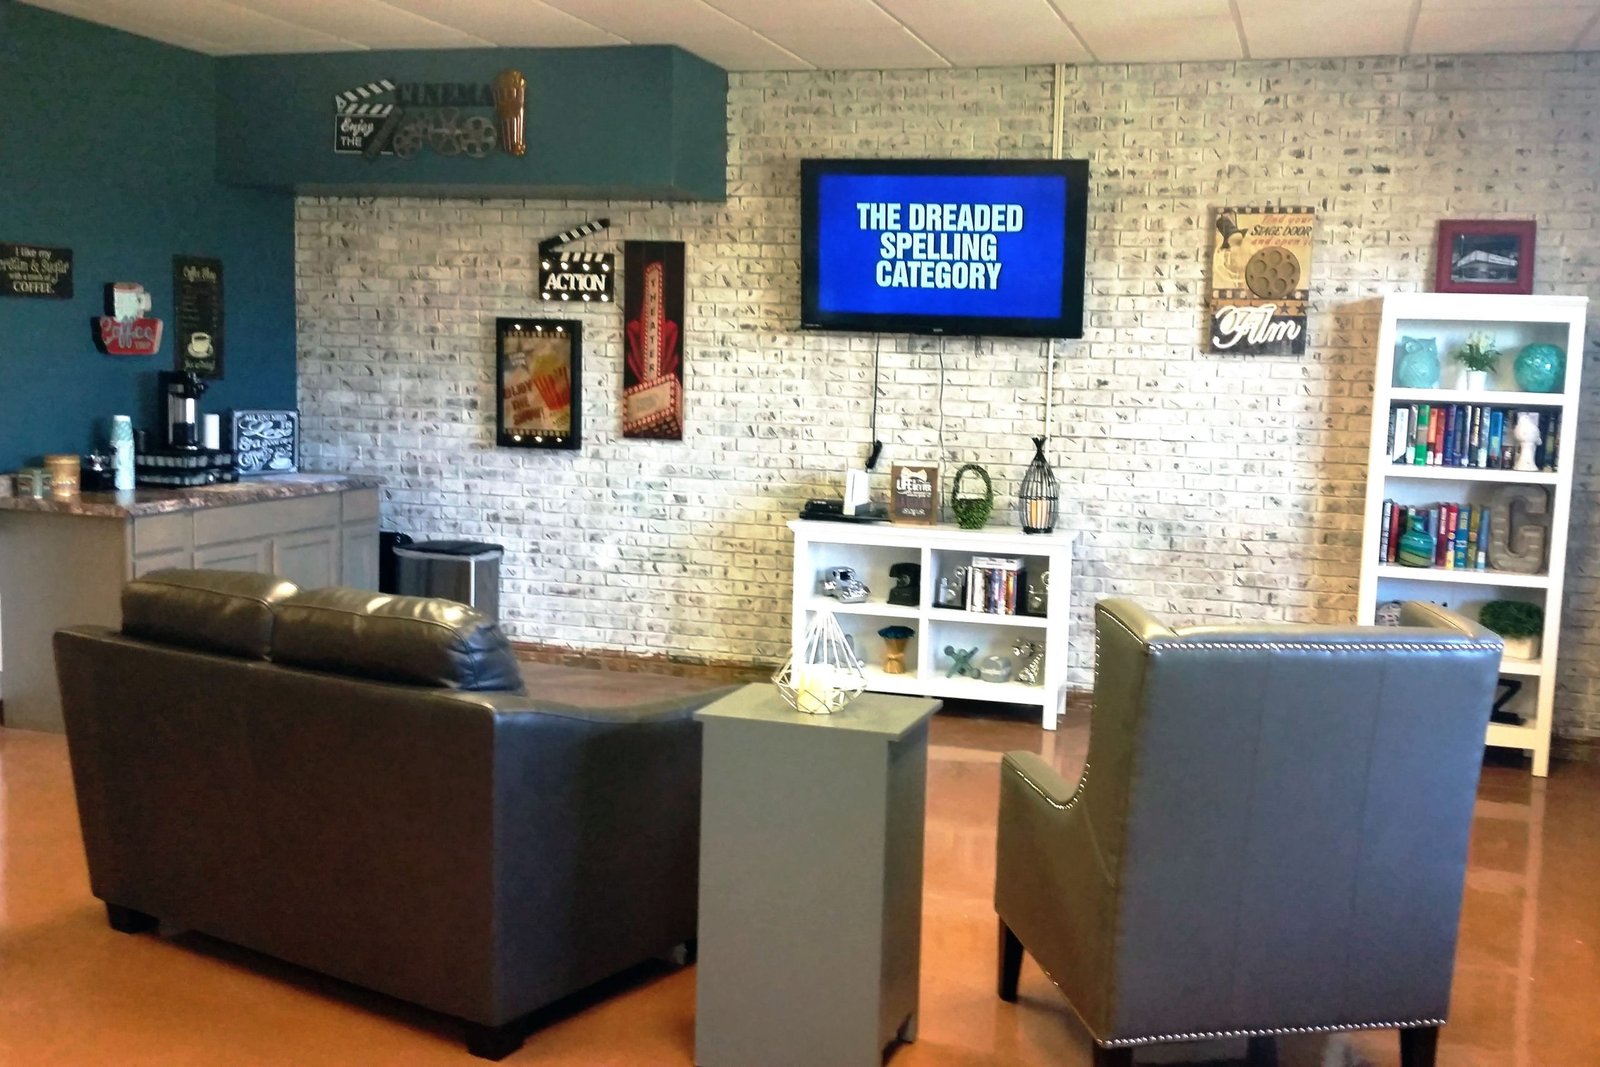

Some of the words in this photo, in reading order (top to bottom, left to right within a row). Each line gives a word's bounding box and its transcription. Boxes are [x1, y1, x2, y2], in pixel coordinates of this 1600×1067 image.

[856, 202, 901, 231] THE
[909, 203, 1023, 232] DREADED
[1250, 224, 1283, 237] STAGE
[1283, 225, 1313, 237] DOOR
[880, 232, 998, 262] SPELLING
[545, 272, 607, 292] ACTION
[876, 261, 1002, 290] CATEGORY
[648, 279, 657, 372] THEATER
[1212, 304, 1302, 349] Film
